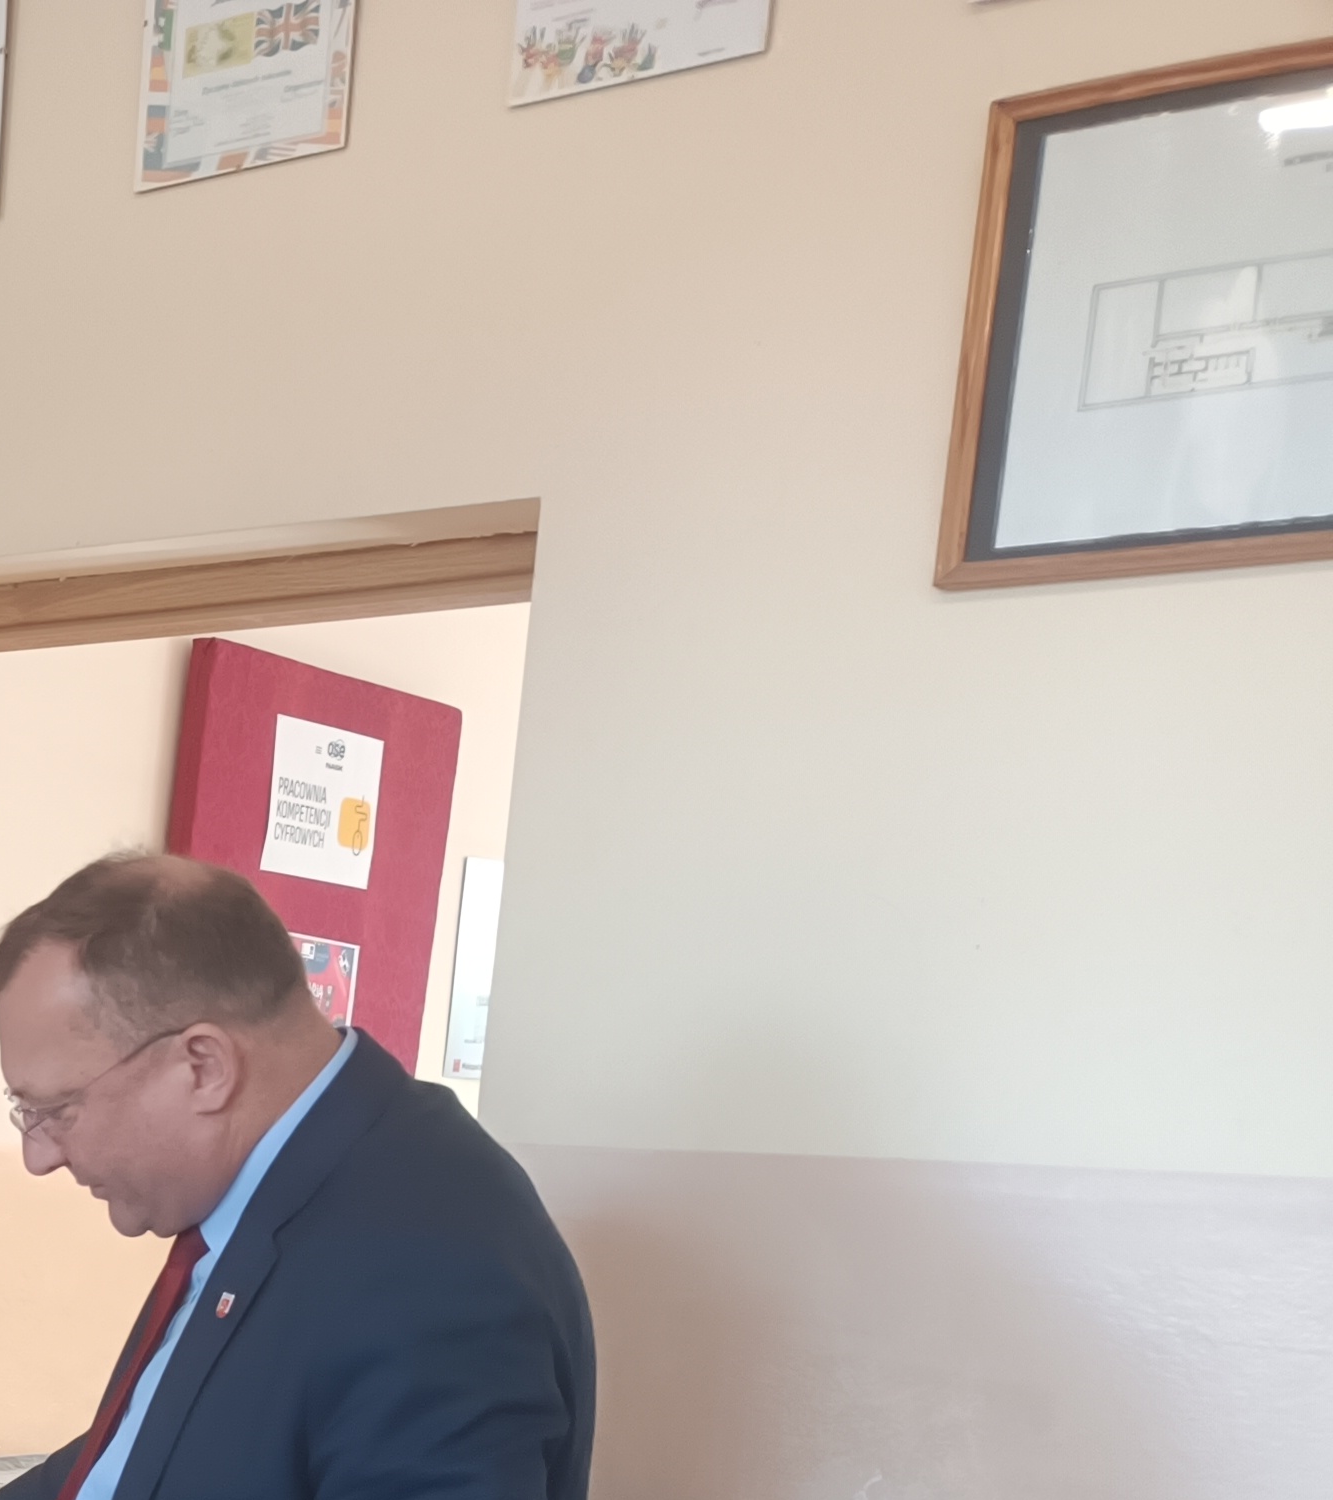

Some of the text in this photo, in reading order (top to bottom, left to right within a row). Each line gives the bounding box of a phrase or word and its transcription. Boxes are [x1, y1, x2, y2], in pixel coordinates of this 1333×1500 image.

[277, 776, 327, 805] PRACOWNIA
[276, 799, 332, 830] KOMPETENCJI
[274, 821, 326, 849] CYFROWYCH
